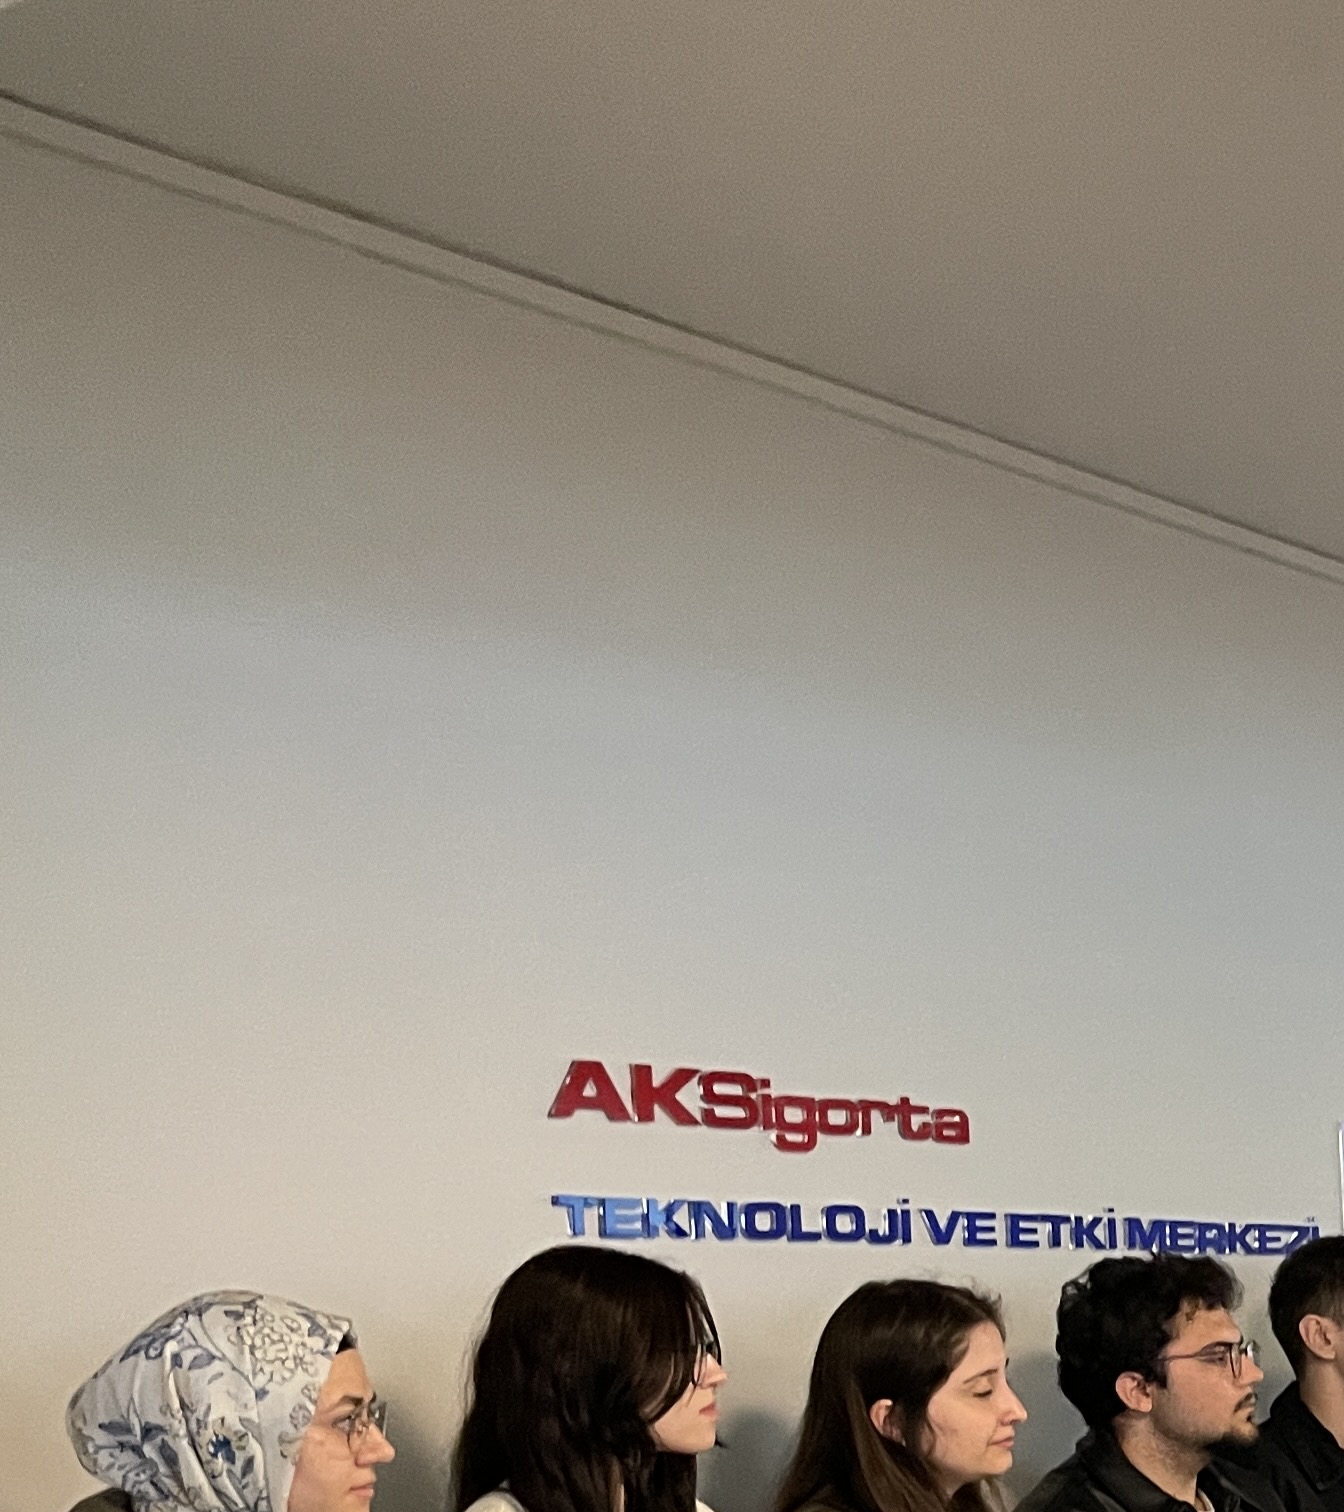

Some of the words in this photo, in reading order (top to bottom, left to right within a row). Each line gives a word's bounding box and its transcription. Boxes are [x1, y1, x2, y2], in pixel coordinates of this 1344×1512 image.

[547, 1059, 971, 1153] AKSigorta
[551, 1194, 912, 1246] TEKNOLOJİ
[920, 1208, 998, 1248] VE
[1004, 1206, 1119, 1252] ETKİ
